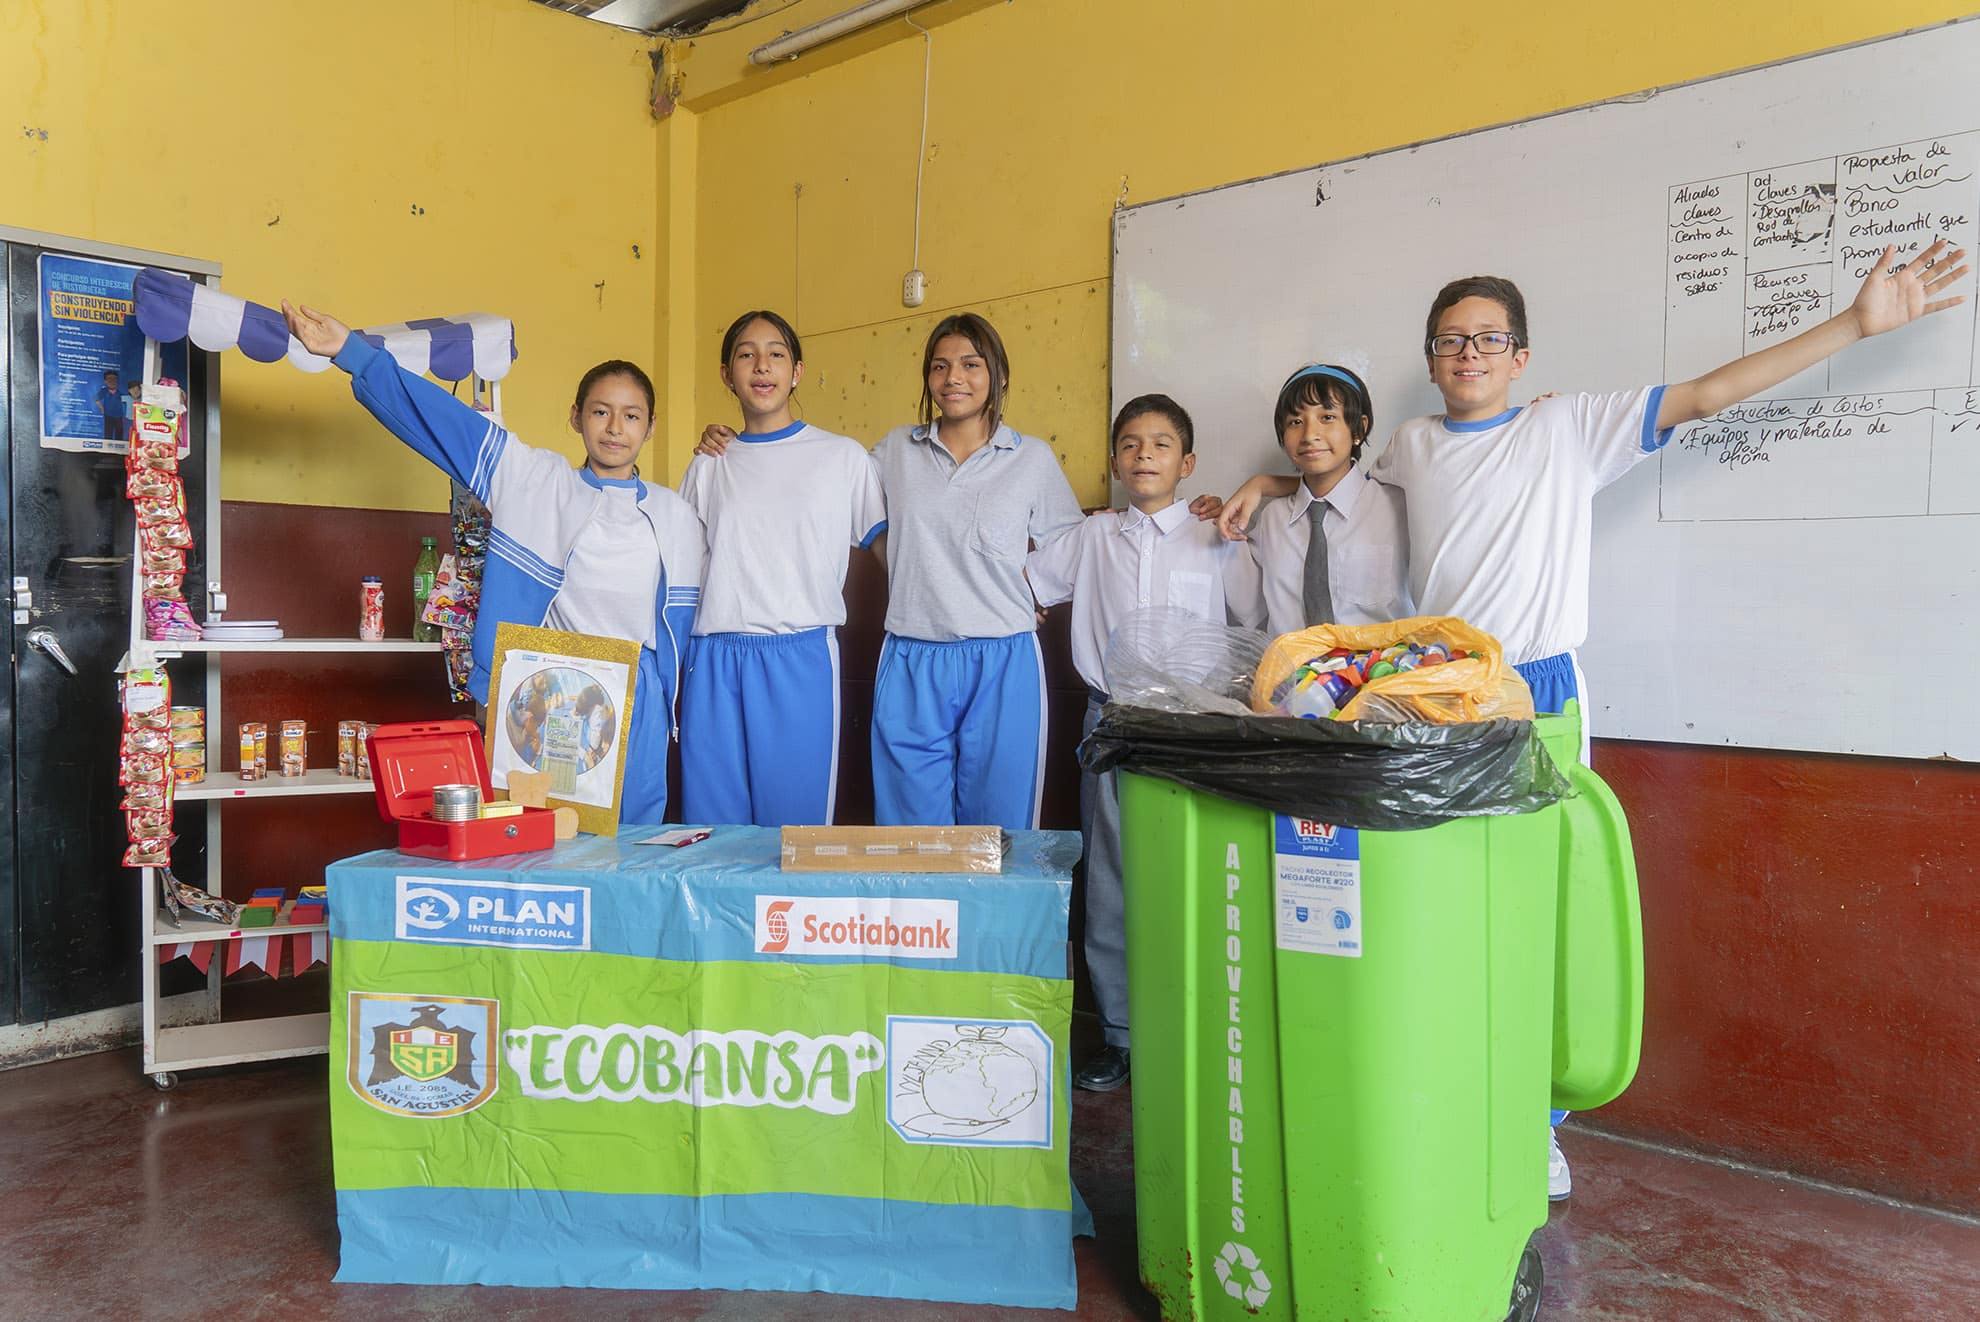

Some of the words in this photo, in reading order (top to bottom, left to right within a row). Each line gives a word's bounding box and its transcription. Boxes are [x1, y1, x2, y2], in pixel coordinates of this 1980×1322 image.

[1926, 141, 1951, 159] de
[1674, 185, 1720, 204] Aliados
[1844, 190, 1899, 217] Banco
[1715, 226, 1734, 238] de
[1849, 212, 1931, 238] estudiantil
[1720, 247, 1739, 257] de
[51, 271, 89, 284] CONCURSO
[1676, 266, 1729, 282] residuos
[51, 281, 59, 291] DE
[62, 281, 107, 295] HISTORIETAS
[55, 304, 71, 316] SIN
[1867, 417, 1892, 435] de
[1300, 820, 1332, 838] REY
[1280, 872, 1332, 885] MEGAFORTE
[1305, 867, 1353, 878] RECOLECTOR
[467, 896, 575, 926] PLAN
[468, 924, 575, 939] INTERNATIONAL
[803, 913, 951, 949] Scotiabank
[1225, 842, 1246, 1233] APROVECHABLES
[370, 1087, 401, 1106] SAN
